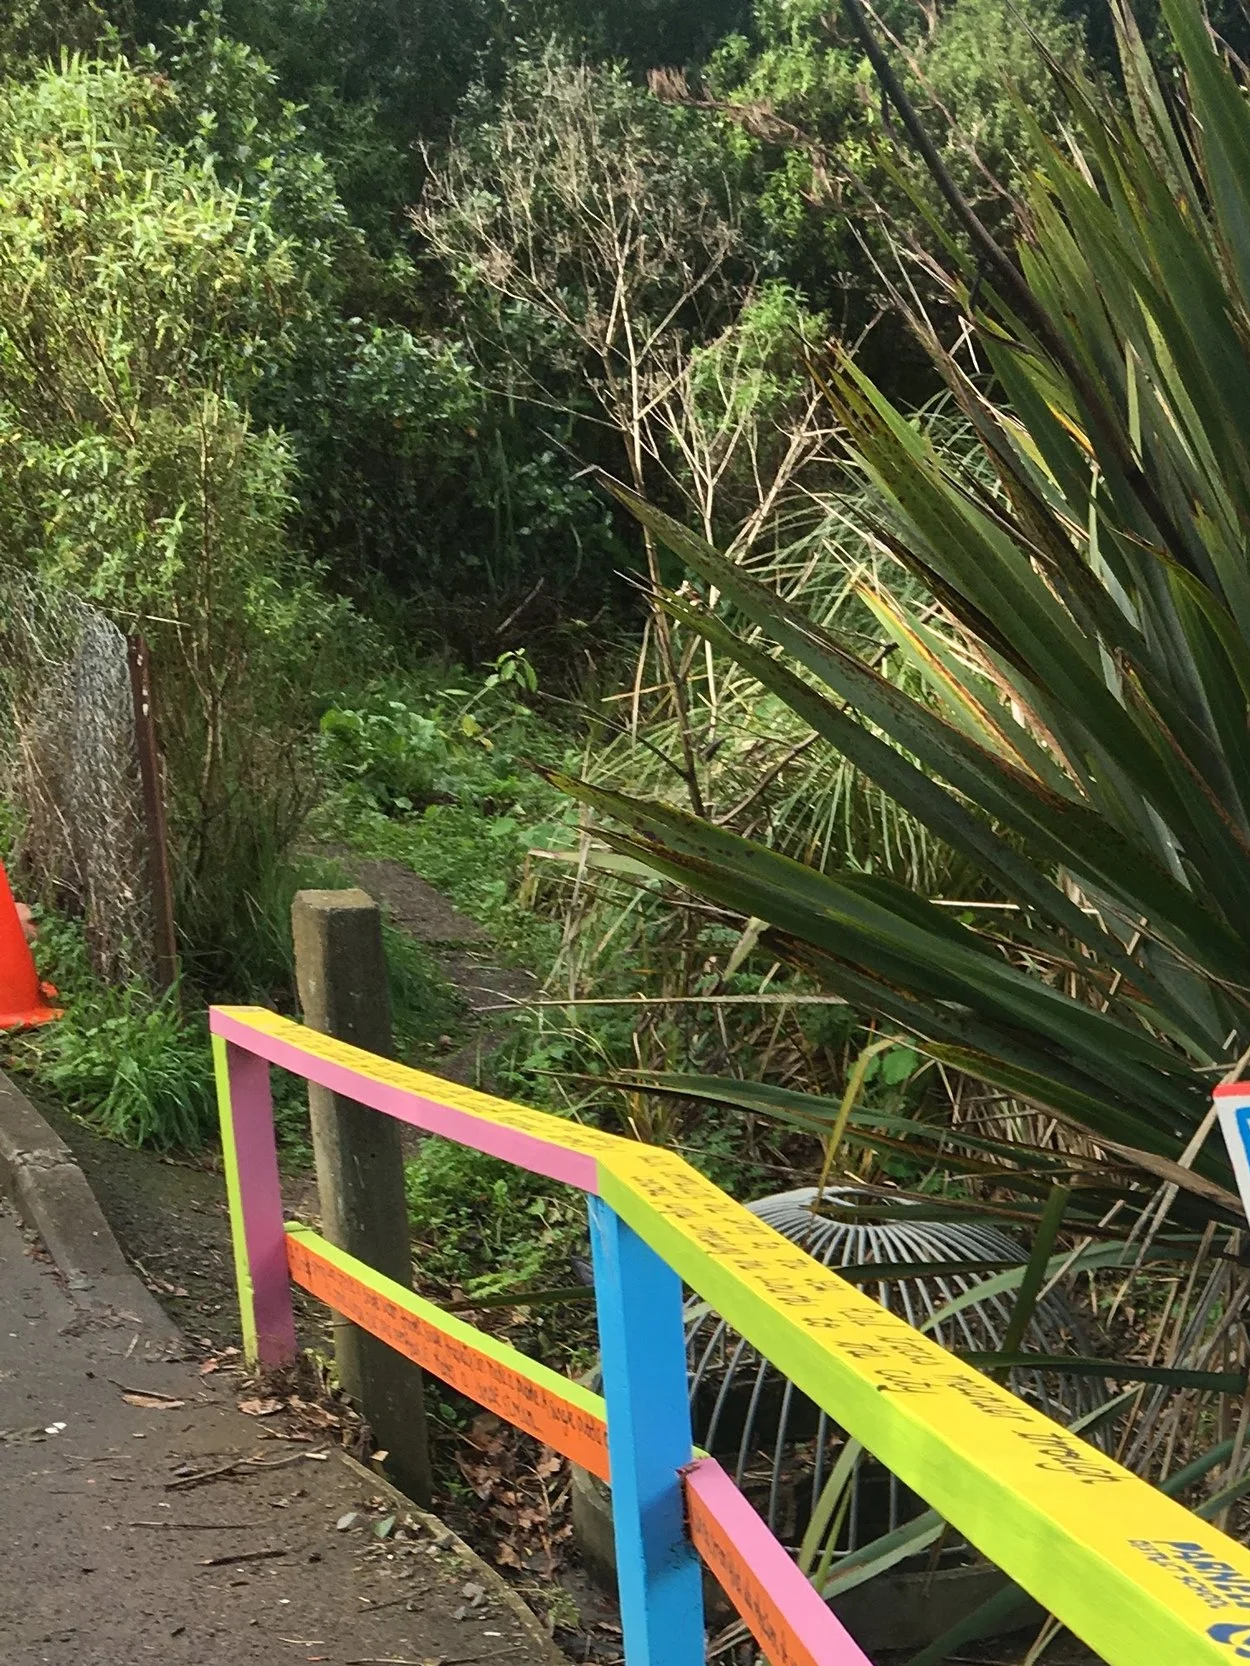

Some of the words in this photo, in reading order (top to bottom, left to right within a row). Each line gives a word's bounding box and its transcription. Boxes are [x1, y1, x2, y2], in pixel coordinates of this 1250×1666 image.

[833, 1340, 890, 1360] the
[873, 1369, 942, 1395] city
[875, 1335, 950, 1366] tracks
[934, 1373, 1035, 1423] meander
[1011, 1430, 1139, 1486] through
